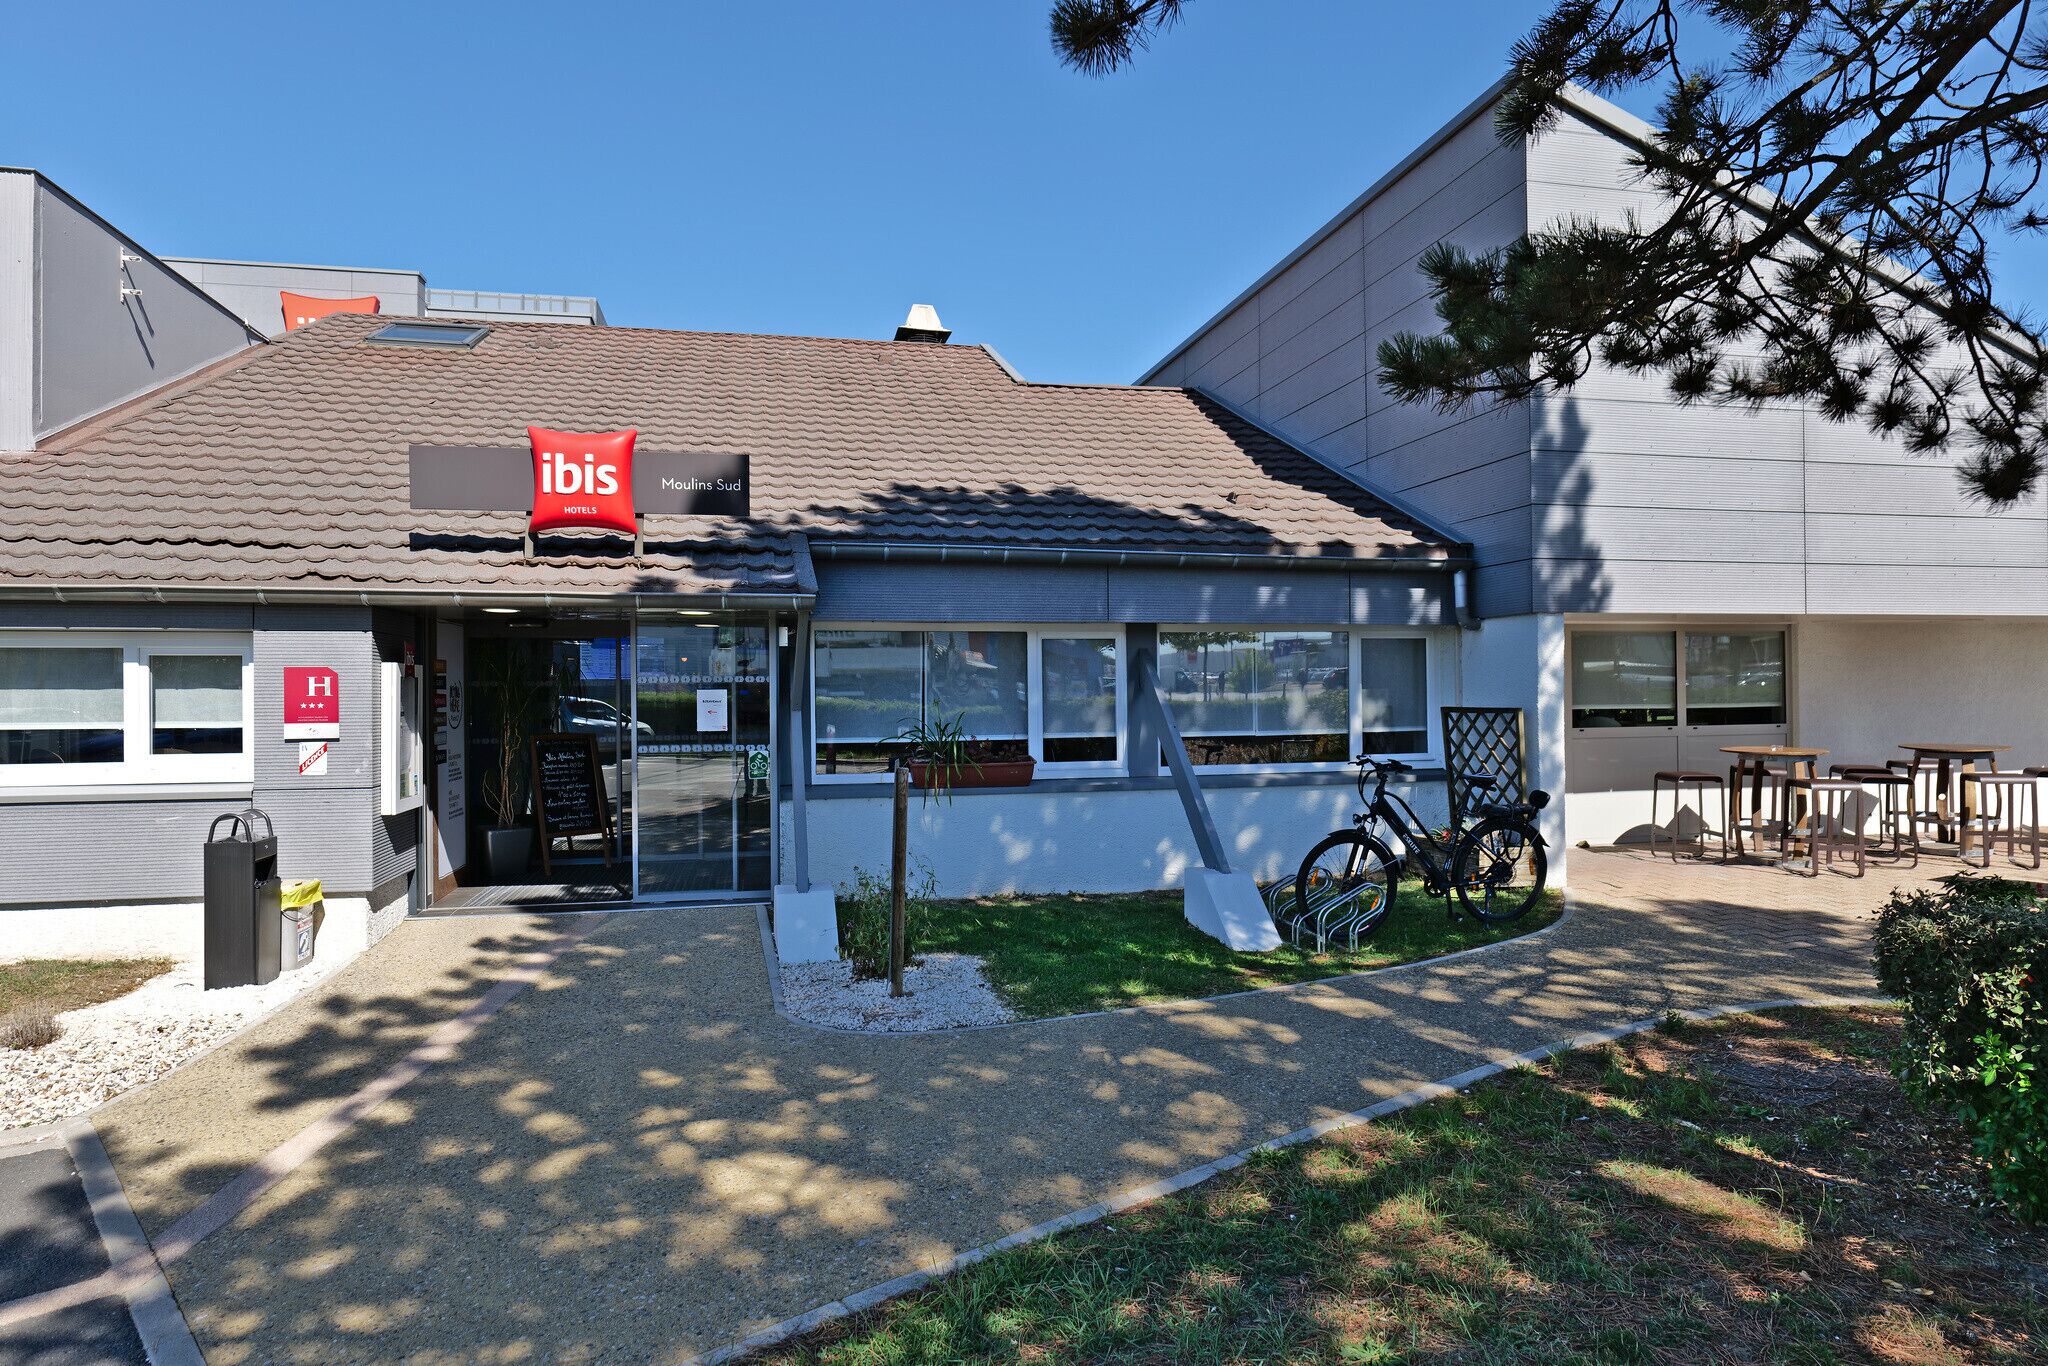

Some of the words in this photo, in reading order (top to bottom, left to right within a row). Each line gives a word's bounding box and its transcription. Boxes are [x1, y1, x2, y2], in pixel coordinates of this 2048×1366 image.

[542, 452, 618, 495] ibis
[662, 477, 713, 491] Moulins
[716, 478, 741, 491] Sud
[564, 506, 597, 514] HOTELS
[306, 676, 333, 697] H
[302, 746, 325, 770] LICENCE
[1403, 834, 1421, 855] ESKUTE
